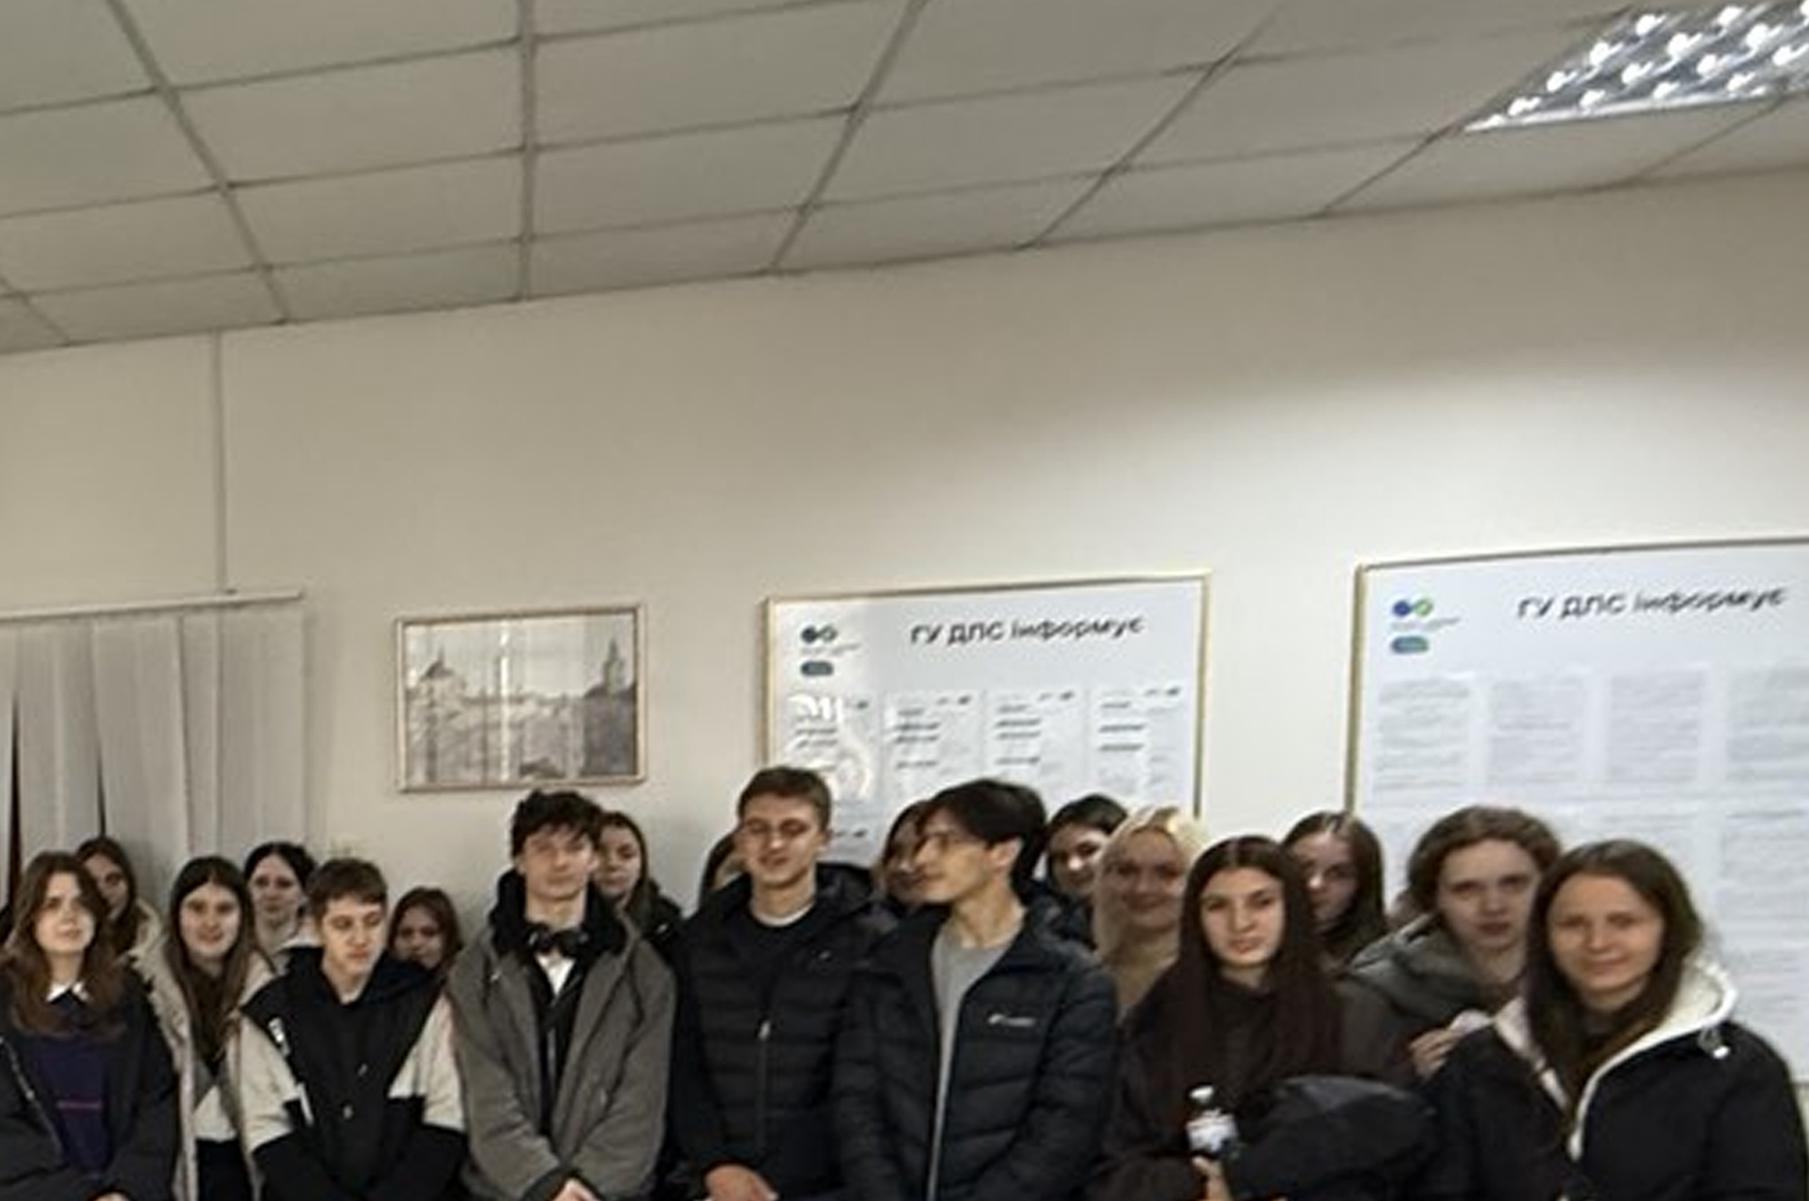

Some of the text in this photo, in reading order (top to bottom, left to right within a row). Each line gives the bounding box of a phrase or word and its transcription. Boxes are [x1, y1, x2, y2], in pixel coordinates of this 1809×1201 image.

[1517, 596, 1555, 619] ГУ
[1560, 592, 1627, 620] ДПС
[910, 617, 1145, 646] ГУ ДПС інформує
